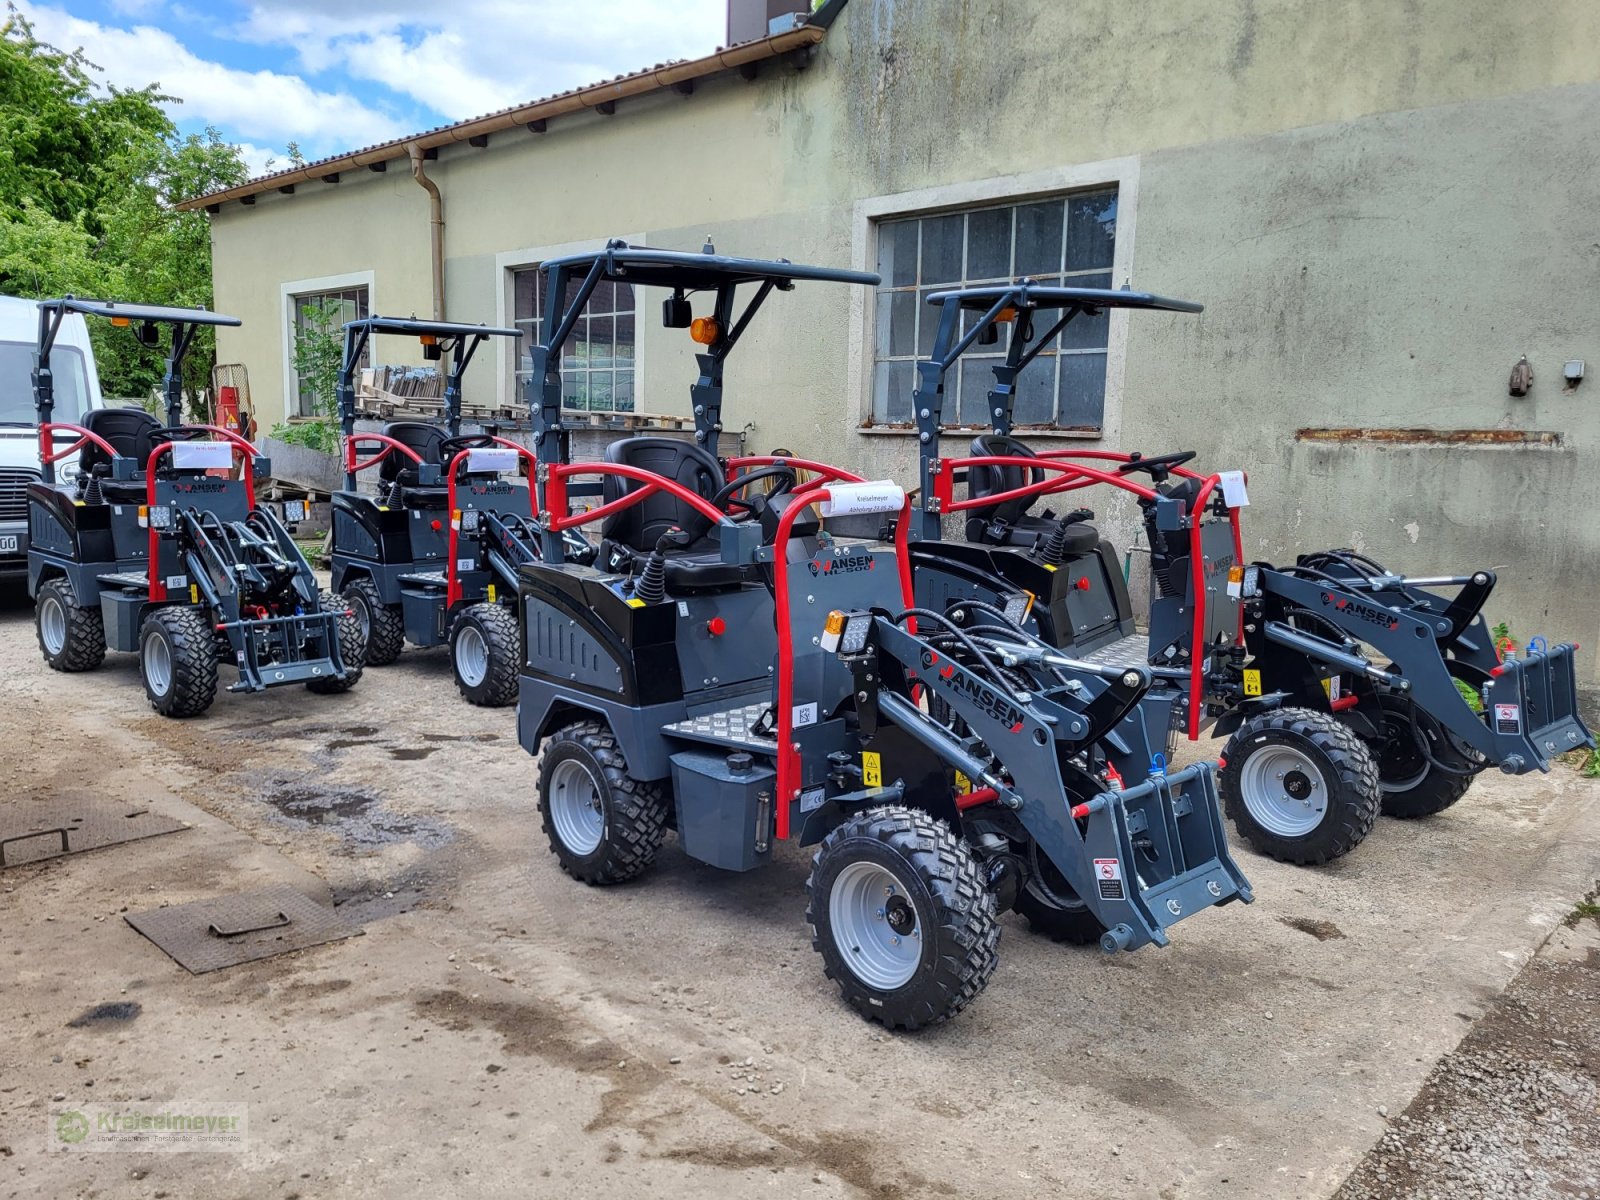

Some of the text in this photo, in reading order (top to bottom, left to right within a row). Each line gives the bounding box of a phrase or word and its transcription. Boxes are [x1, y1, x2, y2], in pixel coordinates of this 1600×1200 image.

[856, 495, 889, 503] Kreiselmeyer
[823, 555, 874, 572] JANSEN
[1335, 598, 1399, 625] JANSEN
[940, 664, 1025, 724] JANSEN
